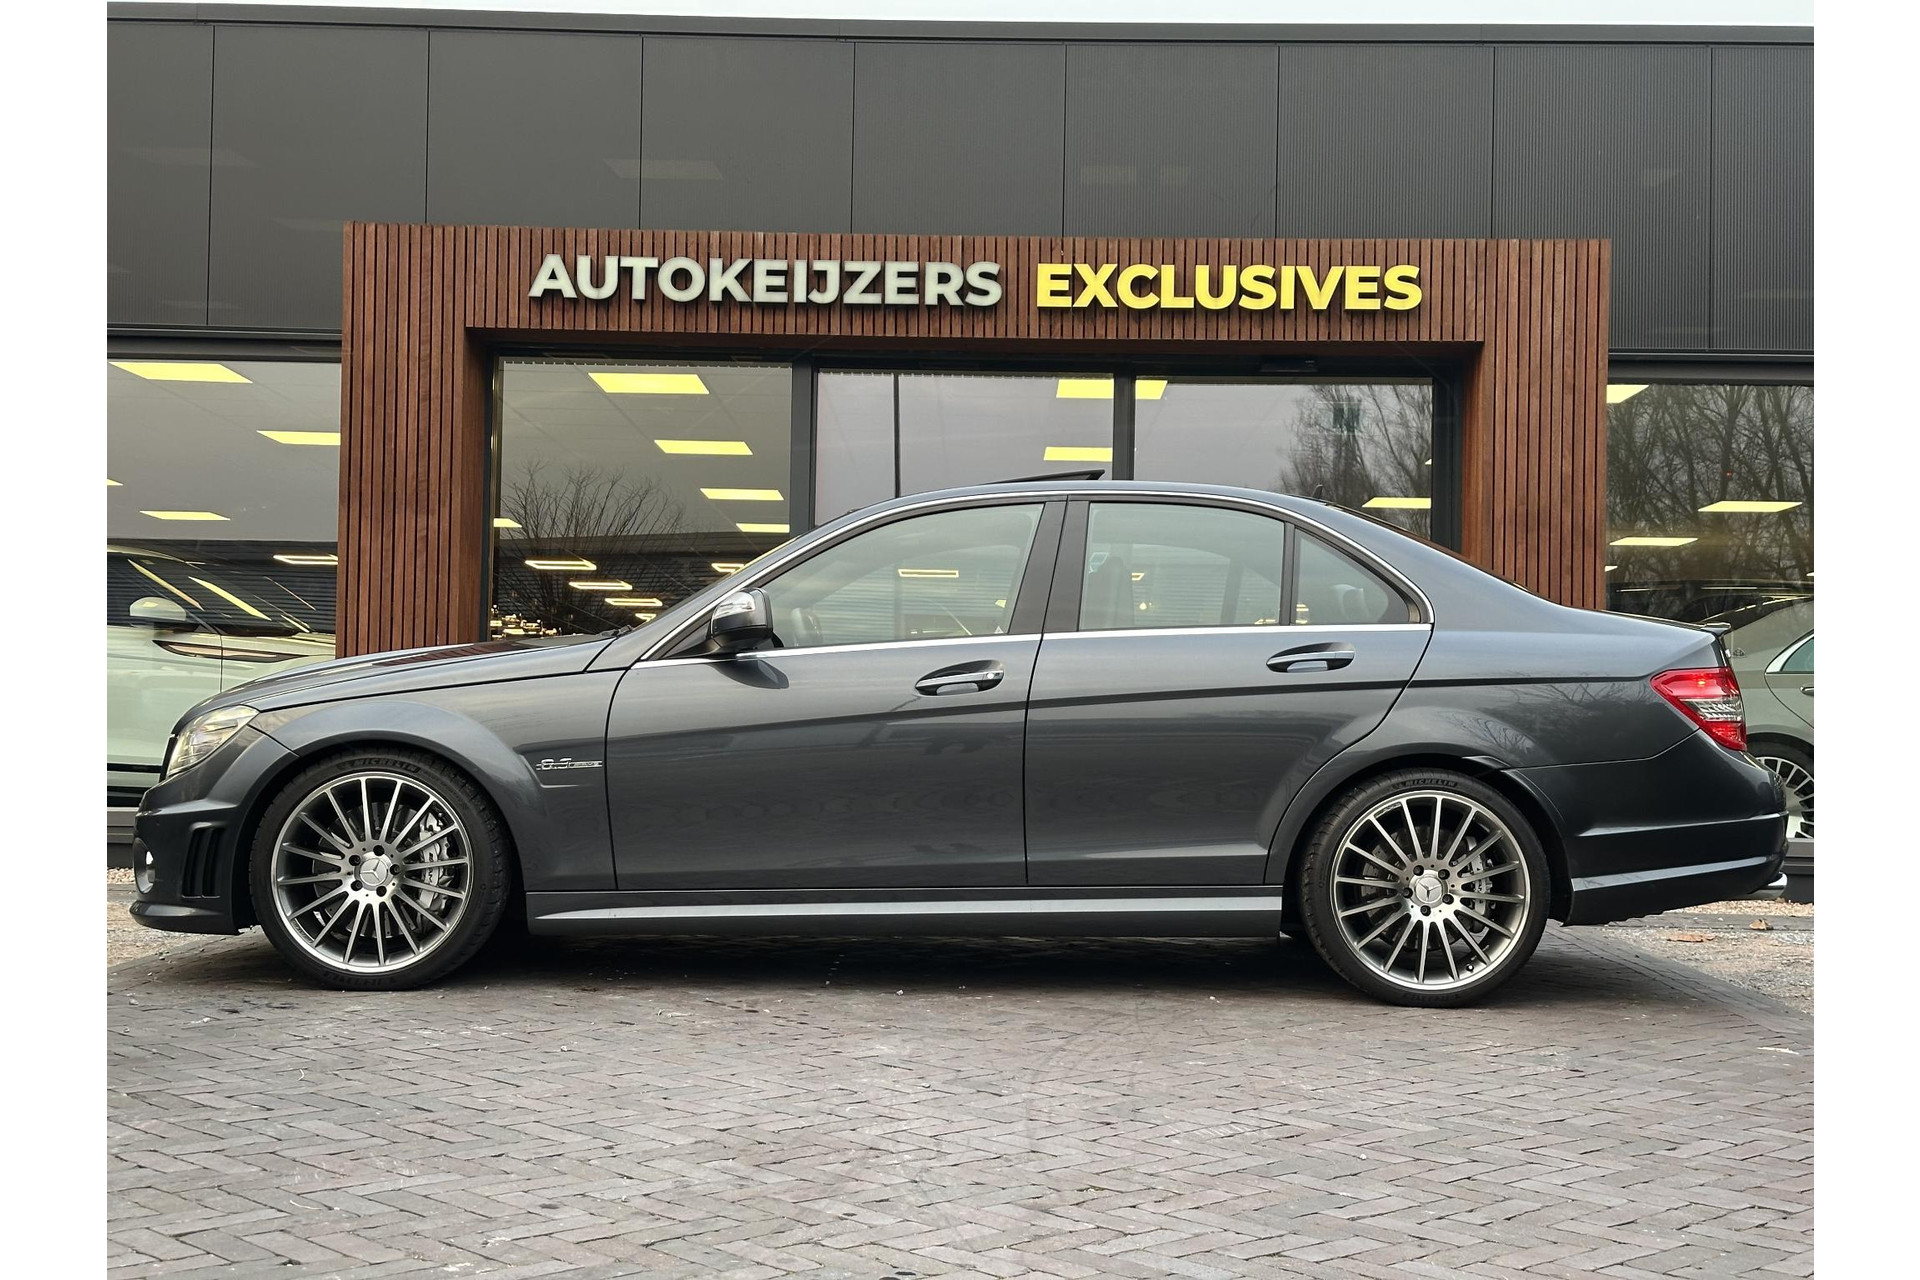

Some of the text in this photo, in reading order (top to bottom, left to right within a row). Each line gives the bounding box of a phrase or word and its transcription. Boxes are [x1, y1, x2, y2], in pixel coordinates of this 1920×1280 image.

[528, 253, 1423, 311] AUTOKEIJZERS EXCLUSIVES
[1404, 778, 1457, 788] MICHELIN
